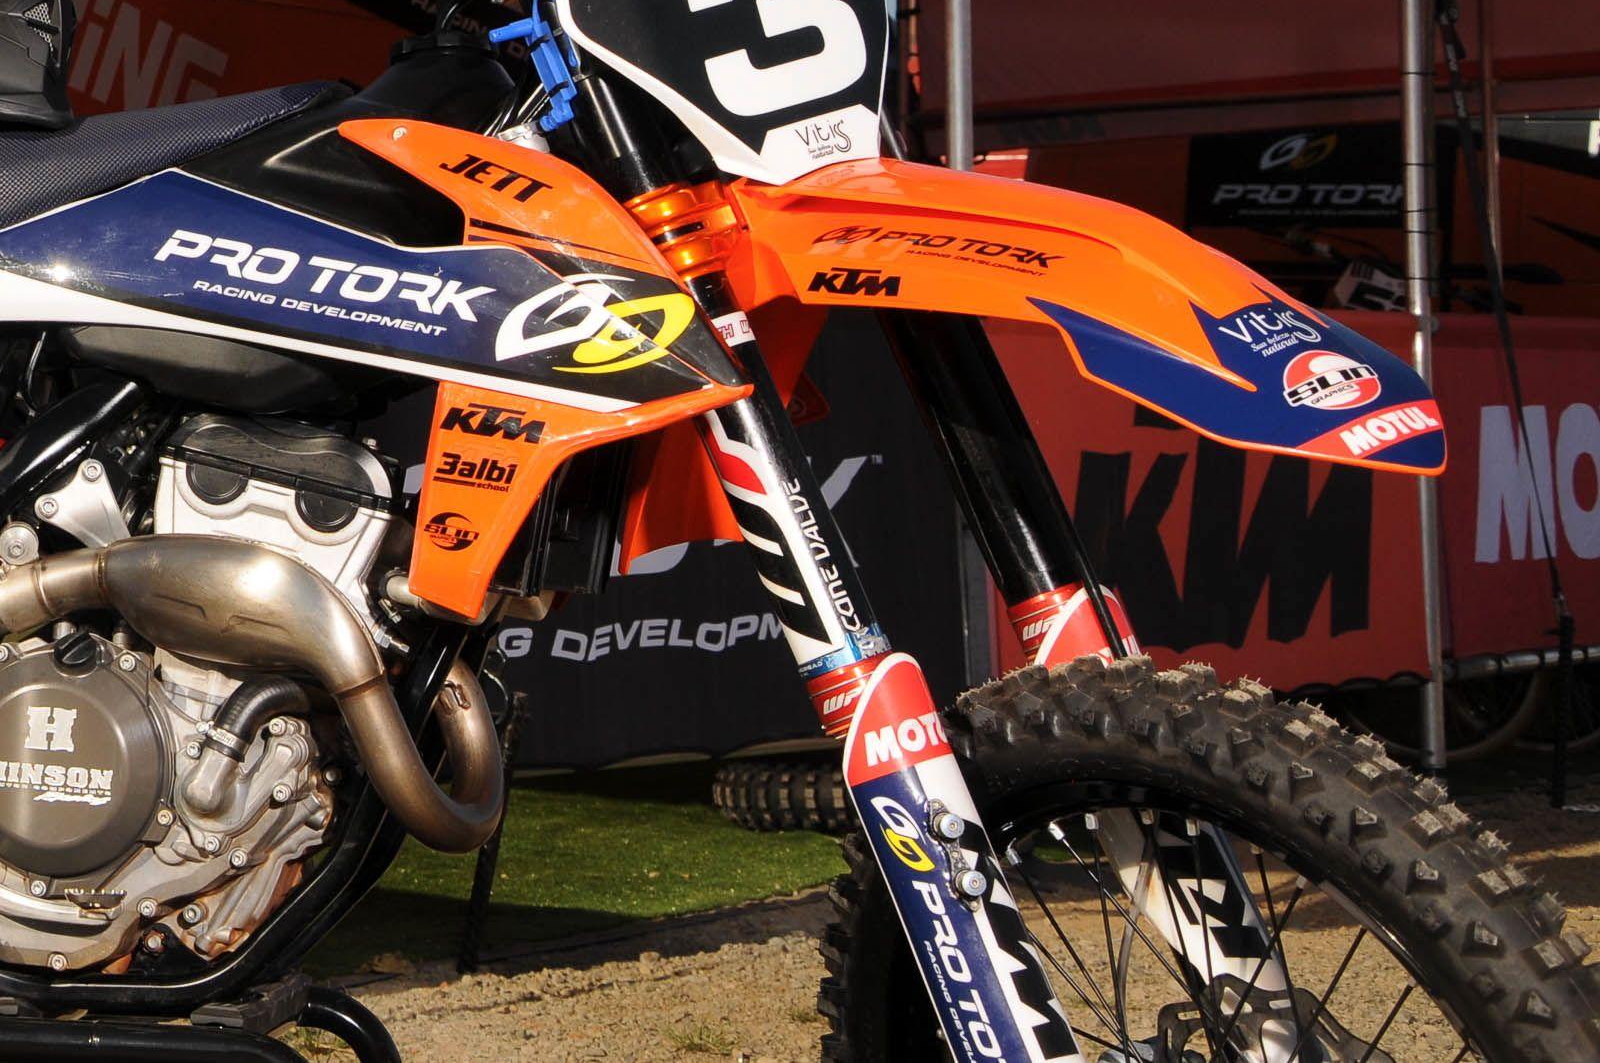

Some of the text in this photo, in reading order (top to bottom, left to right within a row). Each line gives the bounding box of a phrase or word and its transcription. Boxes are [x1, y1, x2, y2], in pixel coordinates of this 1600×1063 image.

[439, 152, 553, 203] JETT
[1212, 183, 1301, 206] PRO
[874, 230, 1066, 269] PRO TORK
[153, 229, 496, 322] PRO TORK
[807, 266, 901, 297] KTM
[193, 279, 448, 336] RACING DEVELOPMENT
[440, 403, 547, 443] KTM
[1339, 406, 1440, 456] MOTUL
[476, 482, 509, 493] school
[911, 880, 1007, 1063] PRO TO
[923, 940, 953, 1004] RACING
